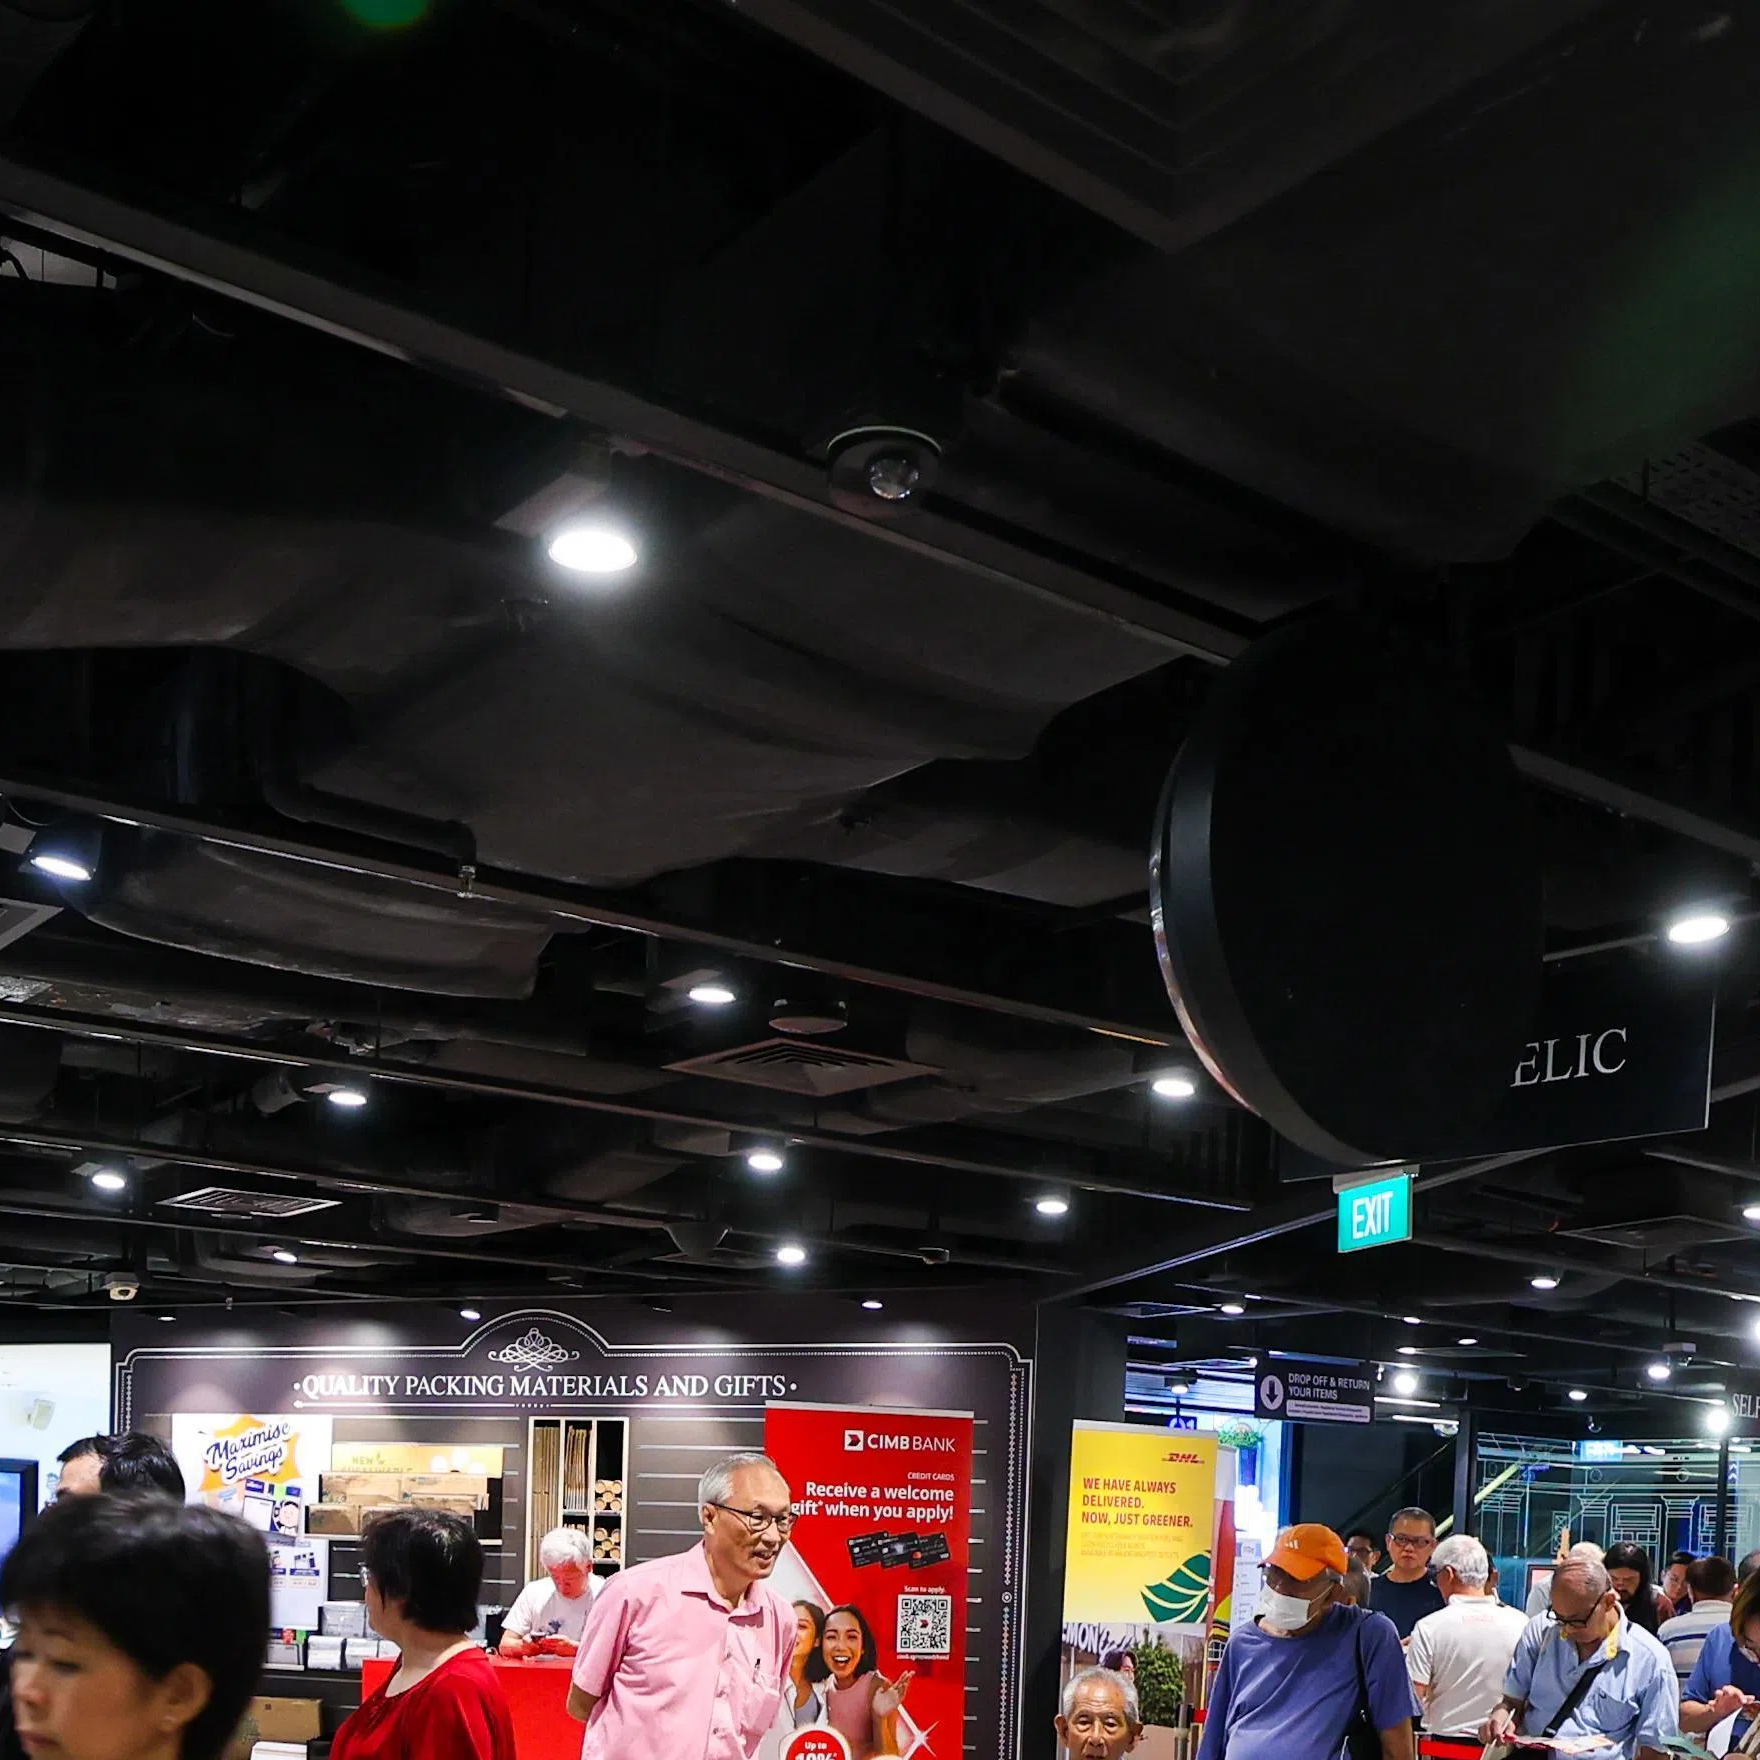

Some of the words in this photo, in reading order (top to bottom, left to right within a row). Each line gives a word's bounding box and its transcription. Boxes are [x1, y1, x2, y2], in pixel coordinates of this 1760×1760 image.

[1352, 1190, 1394, 1240] EXIT
[302, 1374, 401, 1399] QUALITY
[405, 1375, 505, 1397] PACKING
[509, 1375, 648, 1397] MATERIALS
[653, 1375, 709, 1397] AND
[714, 1375, 786, 1397] GIFTS
[1288, 1372, 1311, 1385] DROP
[1312, 1374, 1329, 1387] OFF
[1329, 1377, 1336, 1387] &
[1337, 1378, 1370, 1390] RETURN
[1288, 1386, 1312, 1398] YOUR
[1312, 1388, 1338, 1400] ITEMS
[205, 1421, 291, 1465] Maximise
[867, 1433, 910, 1449] CIMB
[912, 1437, 956, 1452] BANK
[224, 1445, 283, 1480] Savings
[1166, 1453, 1201, 1463] DHL
[907, 1472, 932, 1480] CREDIT
[932, 1473, 955, 1481] CARDS
[806, 1481, 867, 1499] Receive
[870, 1486, 881, 1499] a
[884, 1485, 954, 1501] welcome
[1083, 1477, 1100, 1490] WE
[1103, 1479, 1132, 1491] HAVE
[1134, 1480, 1177, 1494] ALWAYS
[1082, 1494, 1145, 1509] DELIVERED.
[825, 1501, 870, 1518] when
[873, 1505, 903, 1521] you
[906, 1504, 954, 1523] apply!
[1081, 1511, 1111, 1526] NOW,
[1113, 1513, 1140, 1526] JUST
[1142, 1514, 1194, 1528] GREENER.
[904, 1585, 919, 1593] Scan
[804, 1742, 817, 1750] Up
[817, 1742, 827, 1750] to
